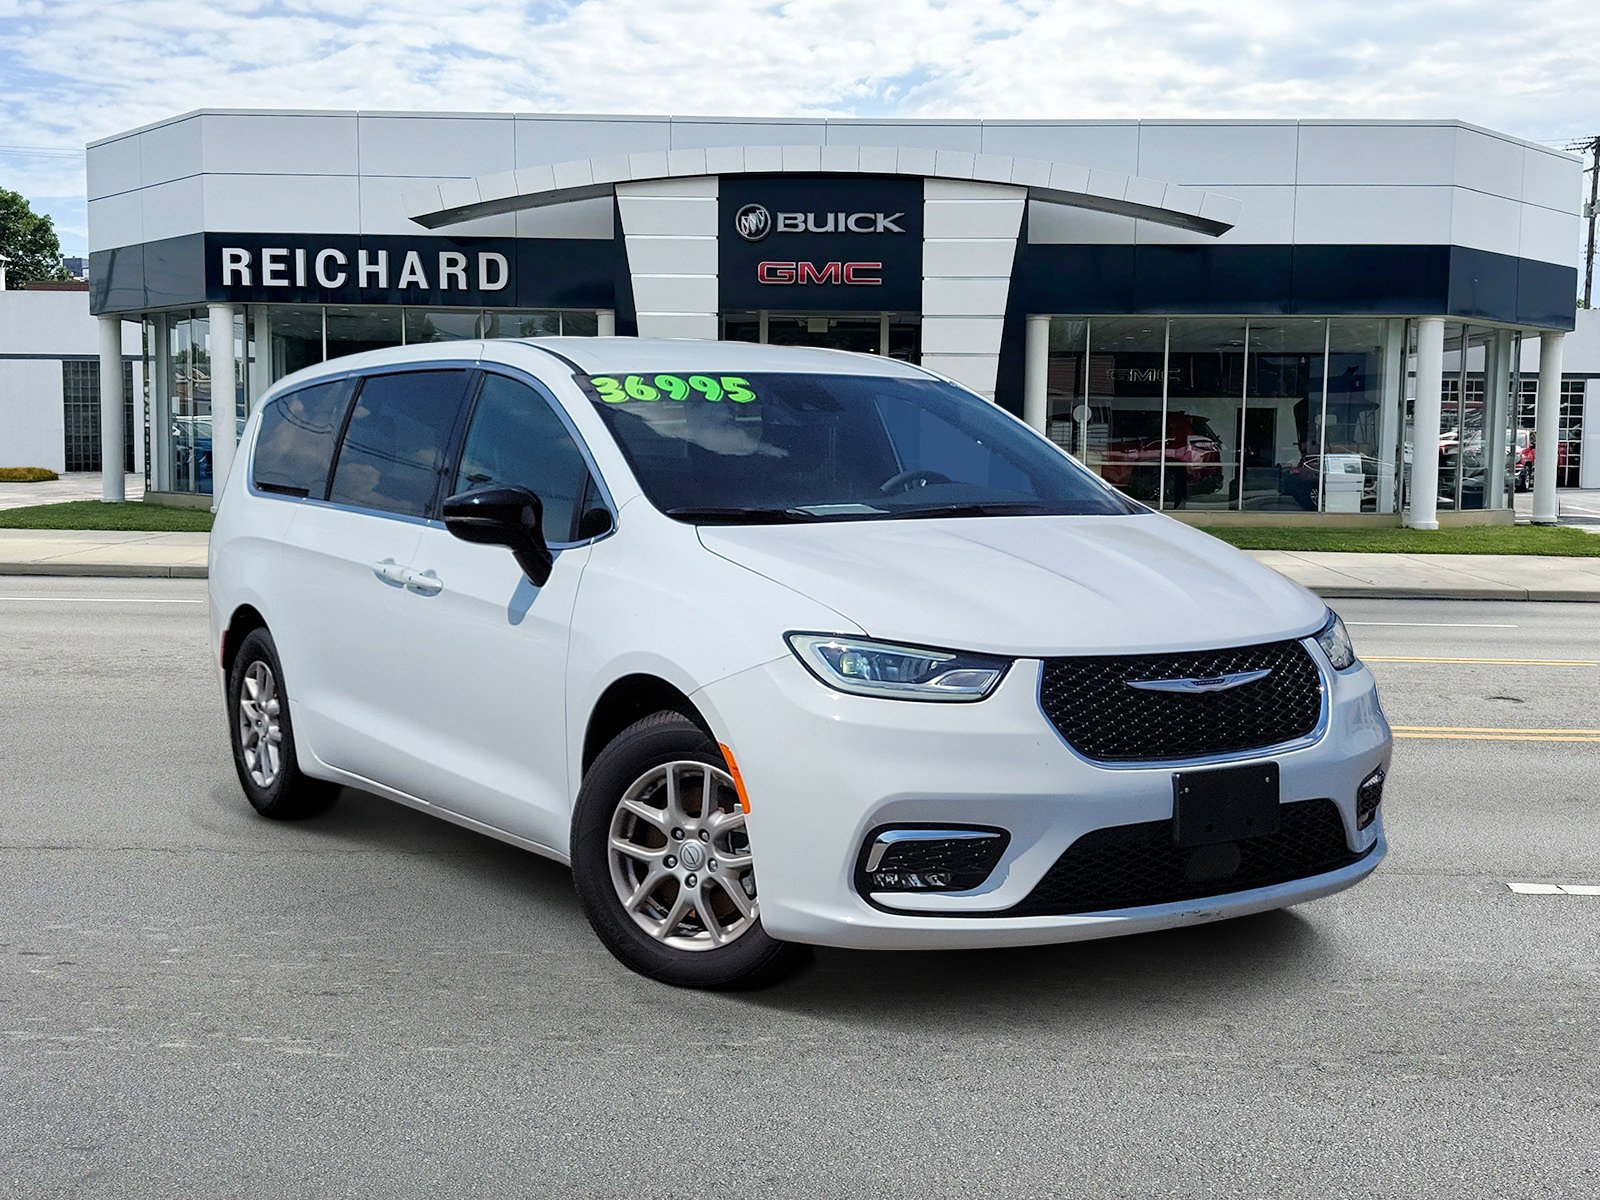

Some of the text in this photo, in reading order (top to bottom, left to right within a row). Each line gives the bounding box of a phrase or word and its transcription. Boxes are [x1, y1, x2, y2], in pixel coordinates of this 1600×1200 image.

[776, 212, 906, 233] BUICK
[222, 247, 511, 291] REICHARD
[757, 261, 882, 285] GMC
[1106, 368, 1181, 382] GMC
[590, 374, 756, 403] 36995
